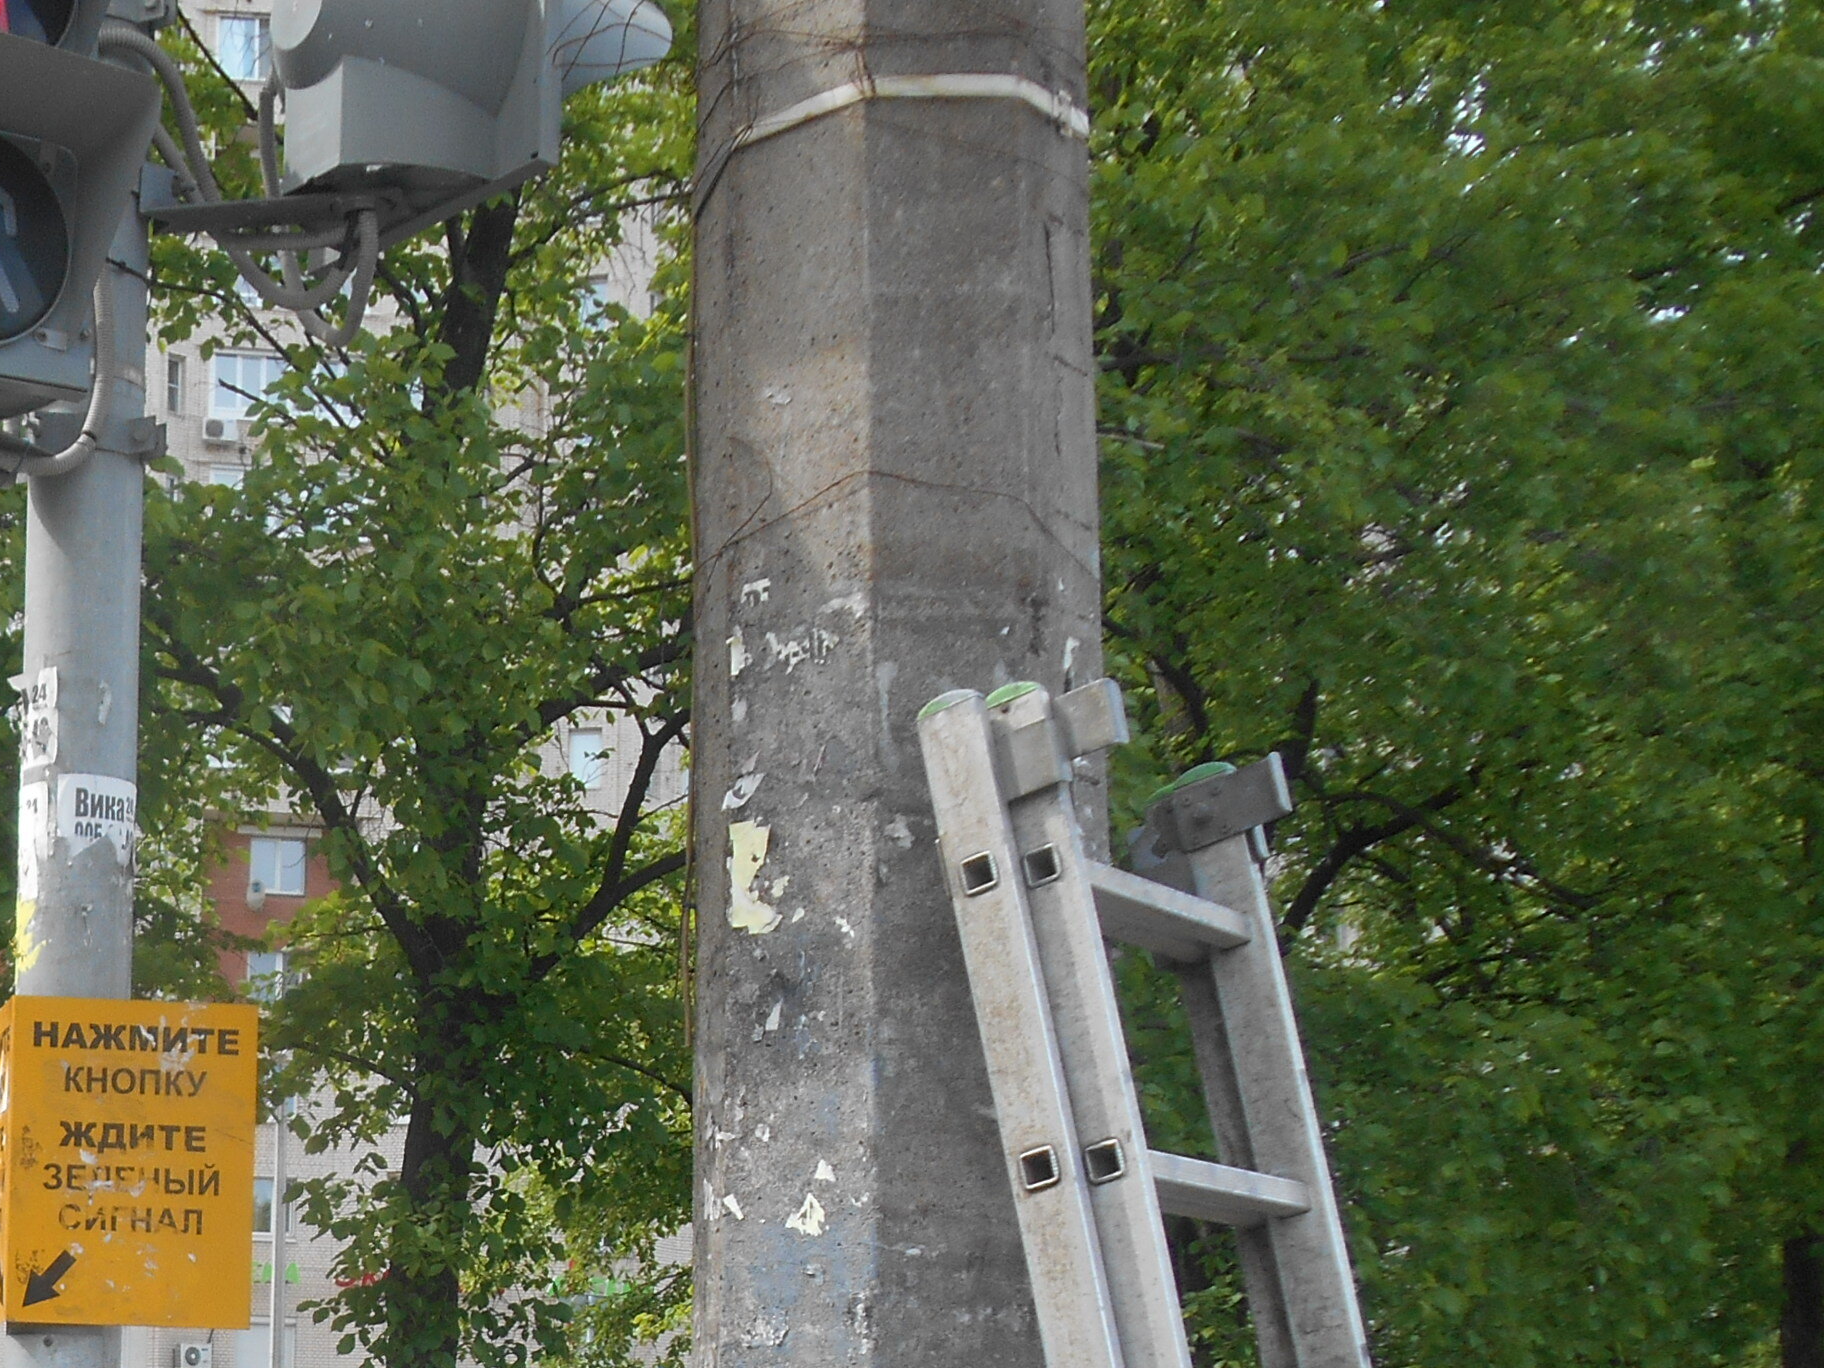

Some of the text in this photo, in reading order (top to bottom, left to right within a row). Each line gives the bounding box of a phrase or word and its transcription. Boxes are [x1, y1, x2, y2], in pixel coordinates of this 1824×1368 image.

[75, 787, 125, 823] Вика
[33, 1021, 240, 1056] НАЖМИТЕ
[64, 1066, 208, 1098] КНОПКУ
[59, 1121, 206, 1153] ЖДИТЕ
[59, 1203, 203, 1235] СИГНАЛ
